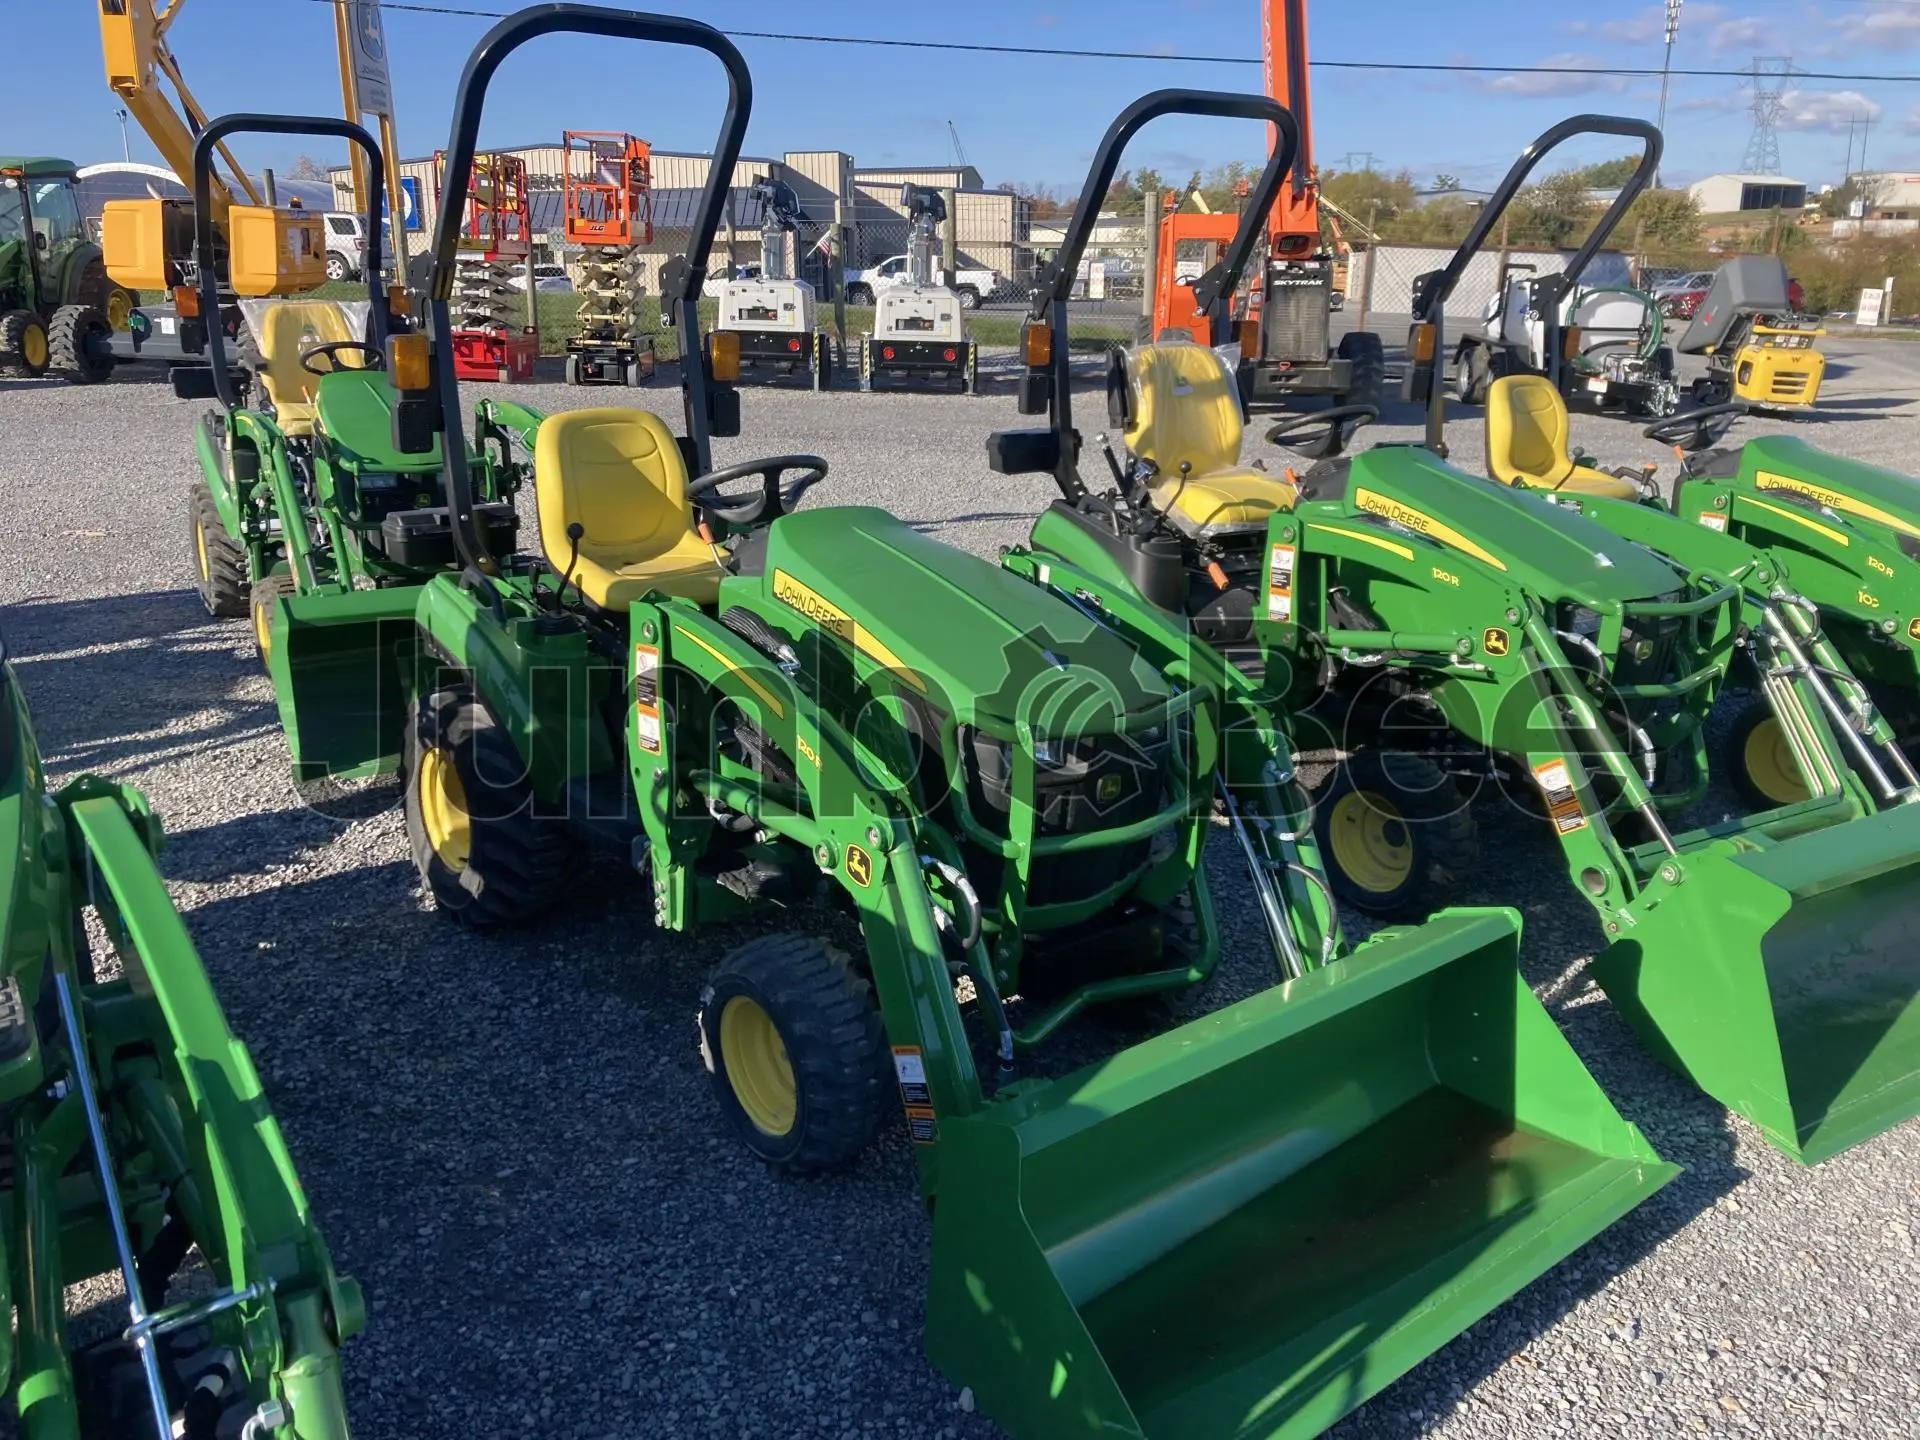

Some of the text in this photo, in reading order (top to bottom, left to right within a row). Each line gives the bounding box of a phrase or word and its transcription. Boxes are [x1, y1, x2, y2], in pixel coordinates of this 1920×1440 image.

[1361, 495, 1429, 531] JOHN DEERE
[778, 579, 845, 633] JOHN DEERE
